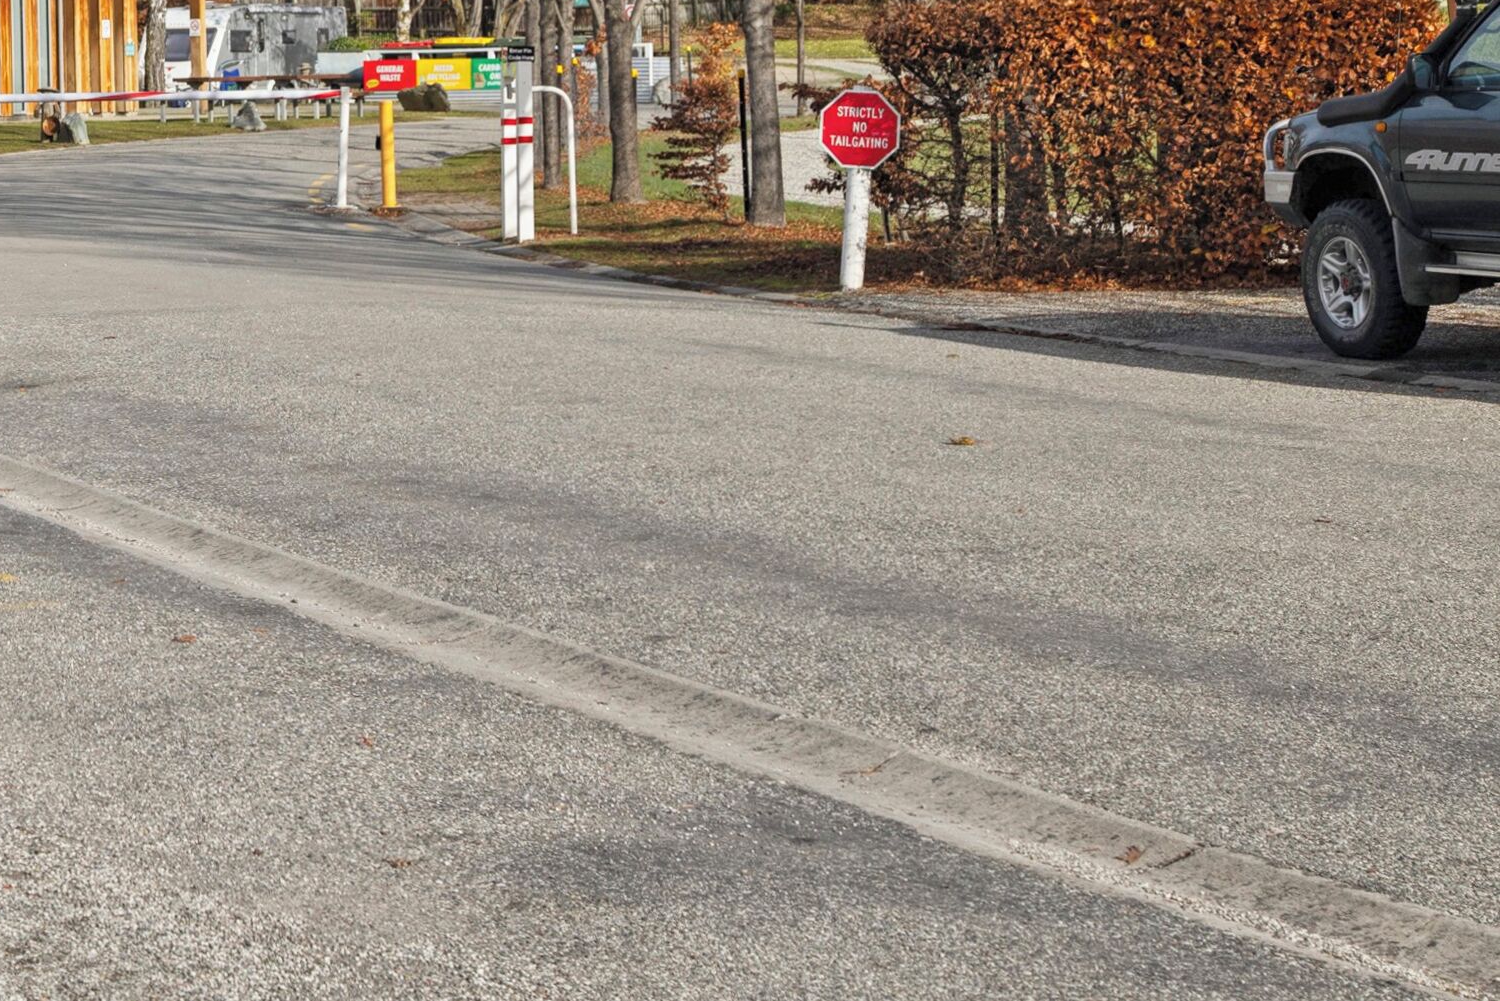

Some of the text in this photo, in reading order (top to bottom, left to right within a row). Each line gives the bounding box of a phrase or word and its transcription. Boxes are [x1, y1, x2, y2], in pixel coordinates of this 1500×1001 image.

[376, 64, 404, 73] GENERAL
[380, 74, 401, 82] WASTE
[837, 106, 884, 118] STRICTLY
[852, 122, 867, 133] NO
[830, 135, 889, 149] TAILGATING
[1404, 149, 1500, 172] 4Runne
